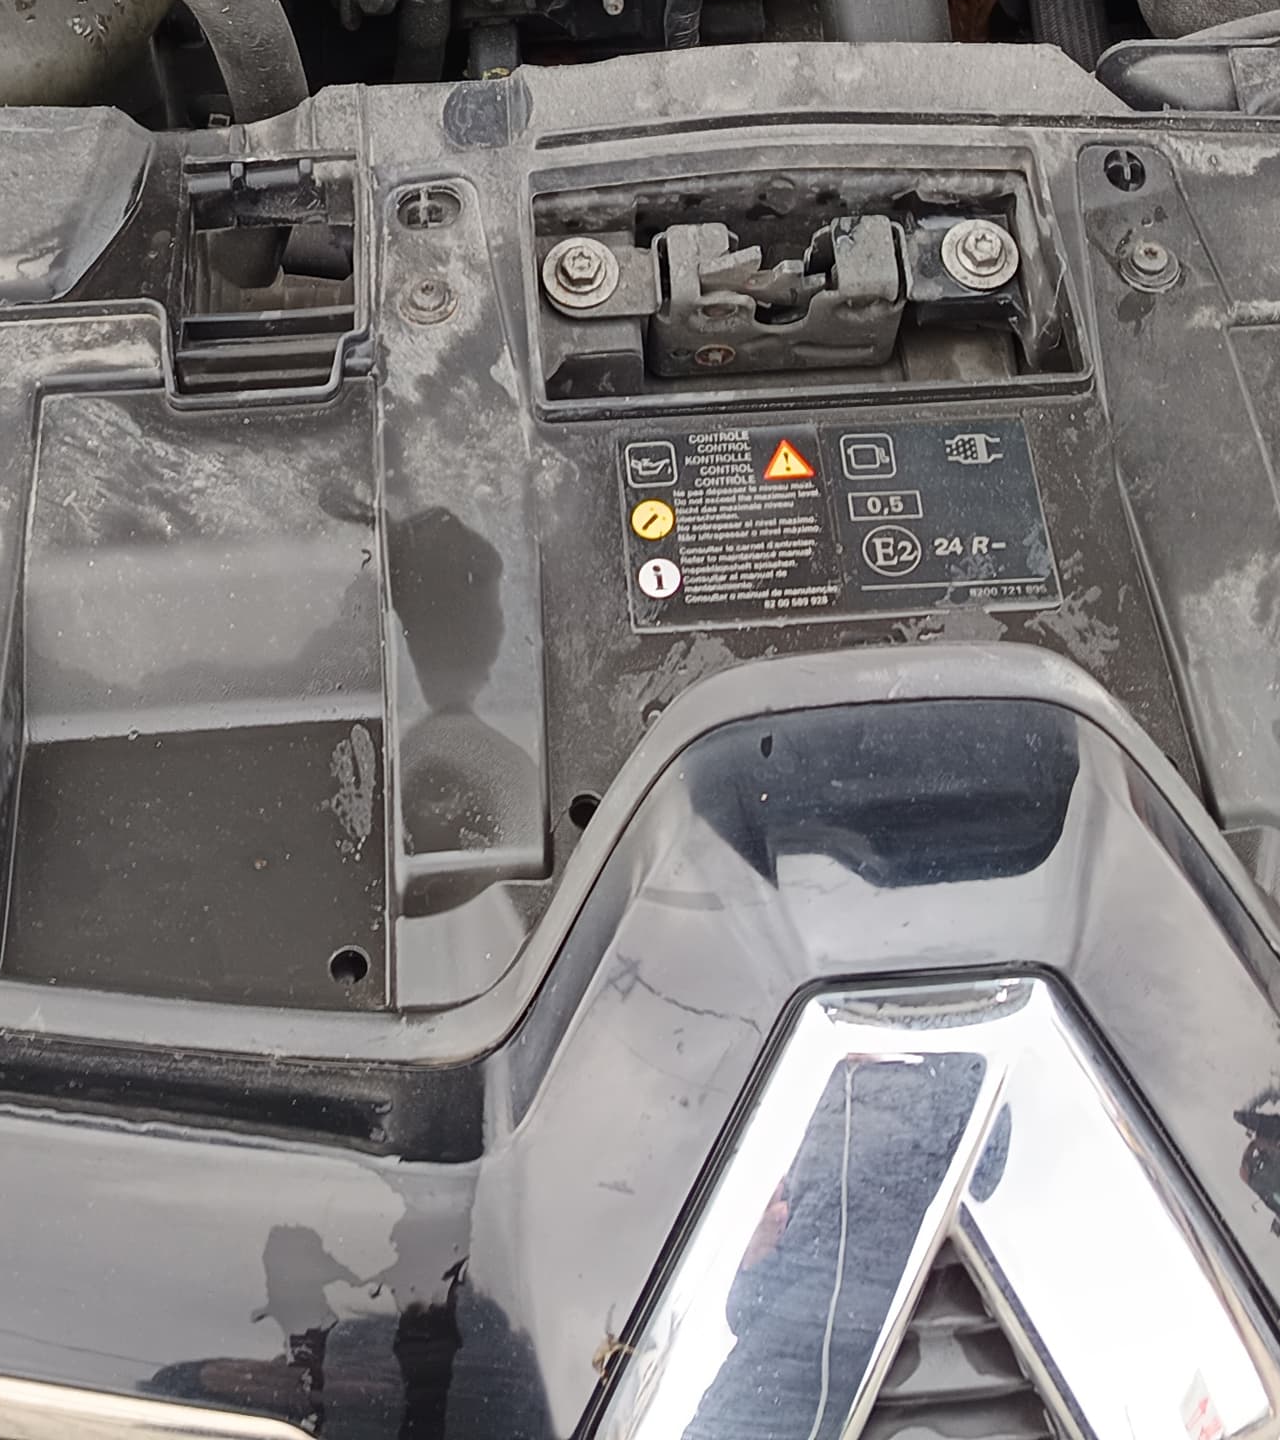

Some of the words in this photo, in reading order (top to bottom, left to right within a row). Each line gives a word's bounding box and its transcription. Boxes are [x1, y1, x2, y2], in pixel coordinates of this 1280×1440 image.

[688, 430, 750, 444] CONTROLE
[697, 442, 752, 454] CONTROL
[684, 452, 753, 466] KONTROLLE
[700, 463, 754, 477] CONTROL
[866, 495, 904, 516] 0,5
[872, 536, 919, 567] E2
[933, 536, 964, 556] 24
[1001, 585, 1022, 595] 721
